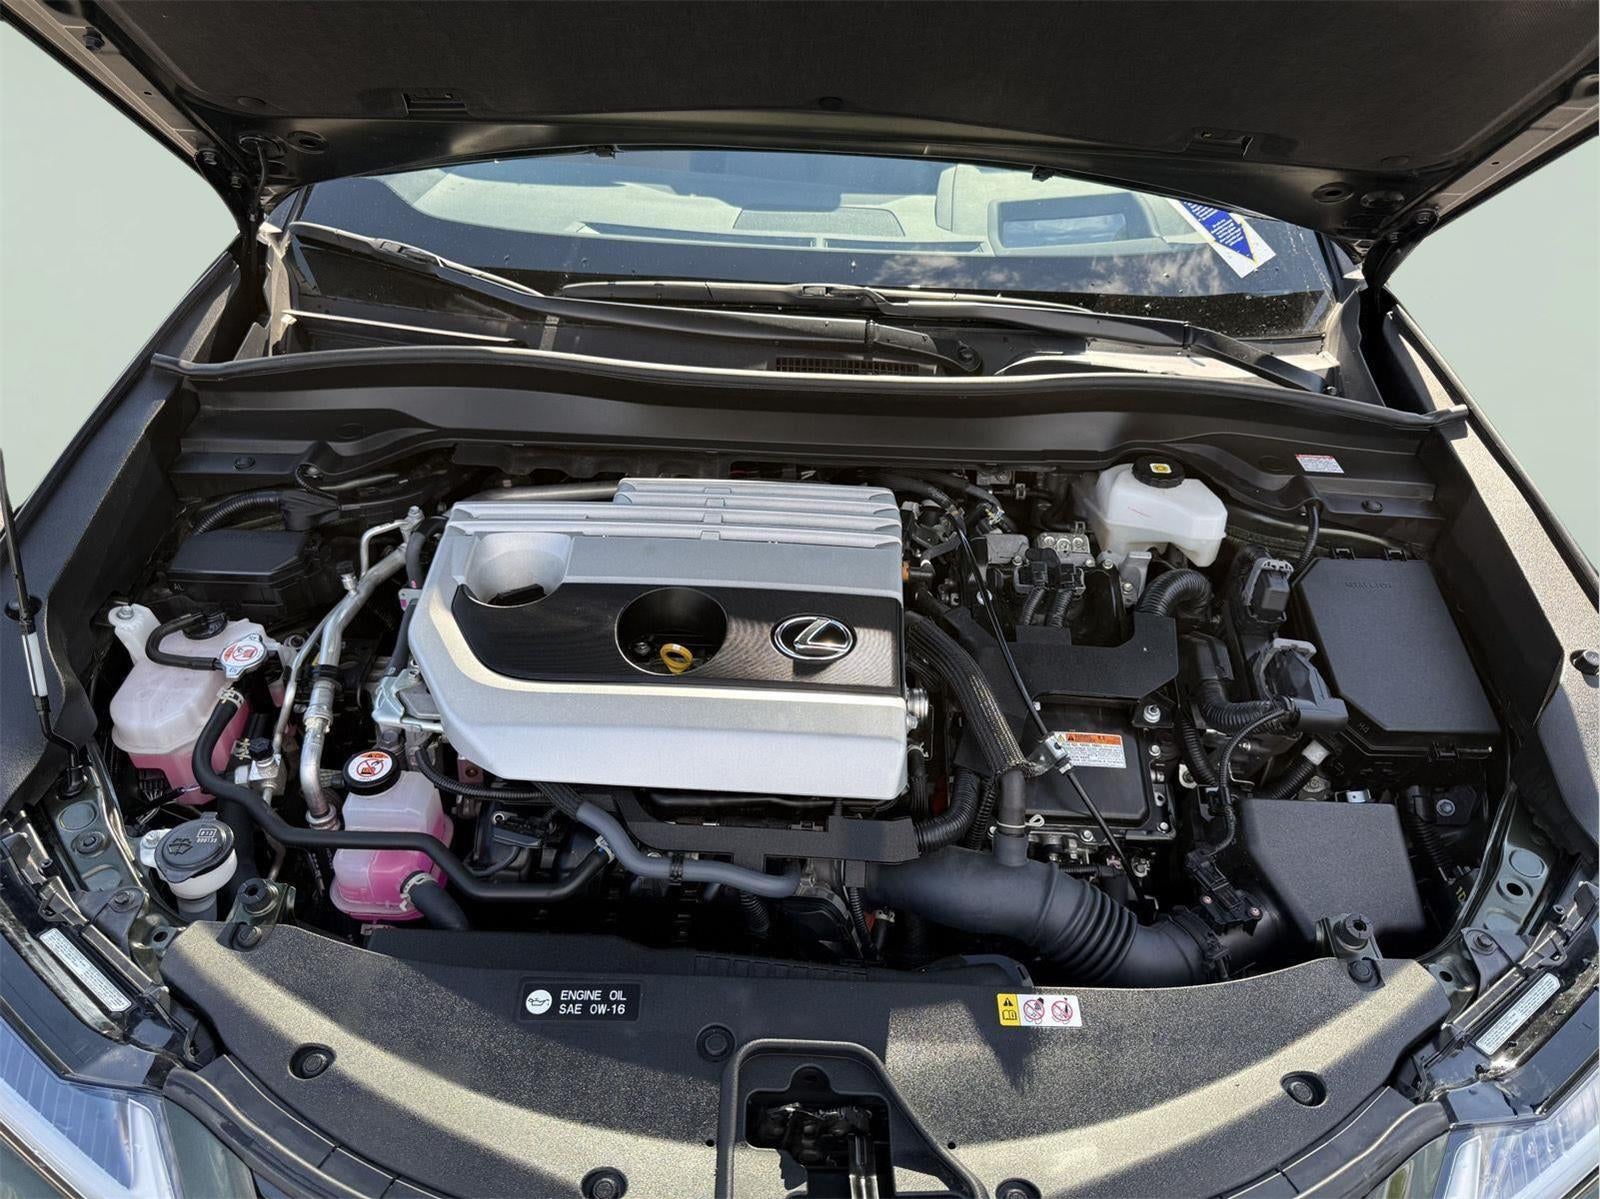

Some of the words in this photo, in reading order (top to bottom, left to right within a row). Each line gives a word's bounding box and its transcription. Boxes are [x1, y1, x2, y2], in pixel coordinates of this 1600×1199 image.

[560, 990, 602, 1001] ENGINE
[609, 990, 627, 1001] OIL
[558, 1003, 583, 1015] SAE
[589, 1003, 626, 1015] 0W-16
